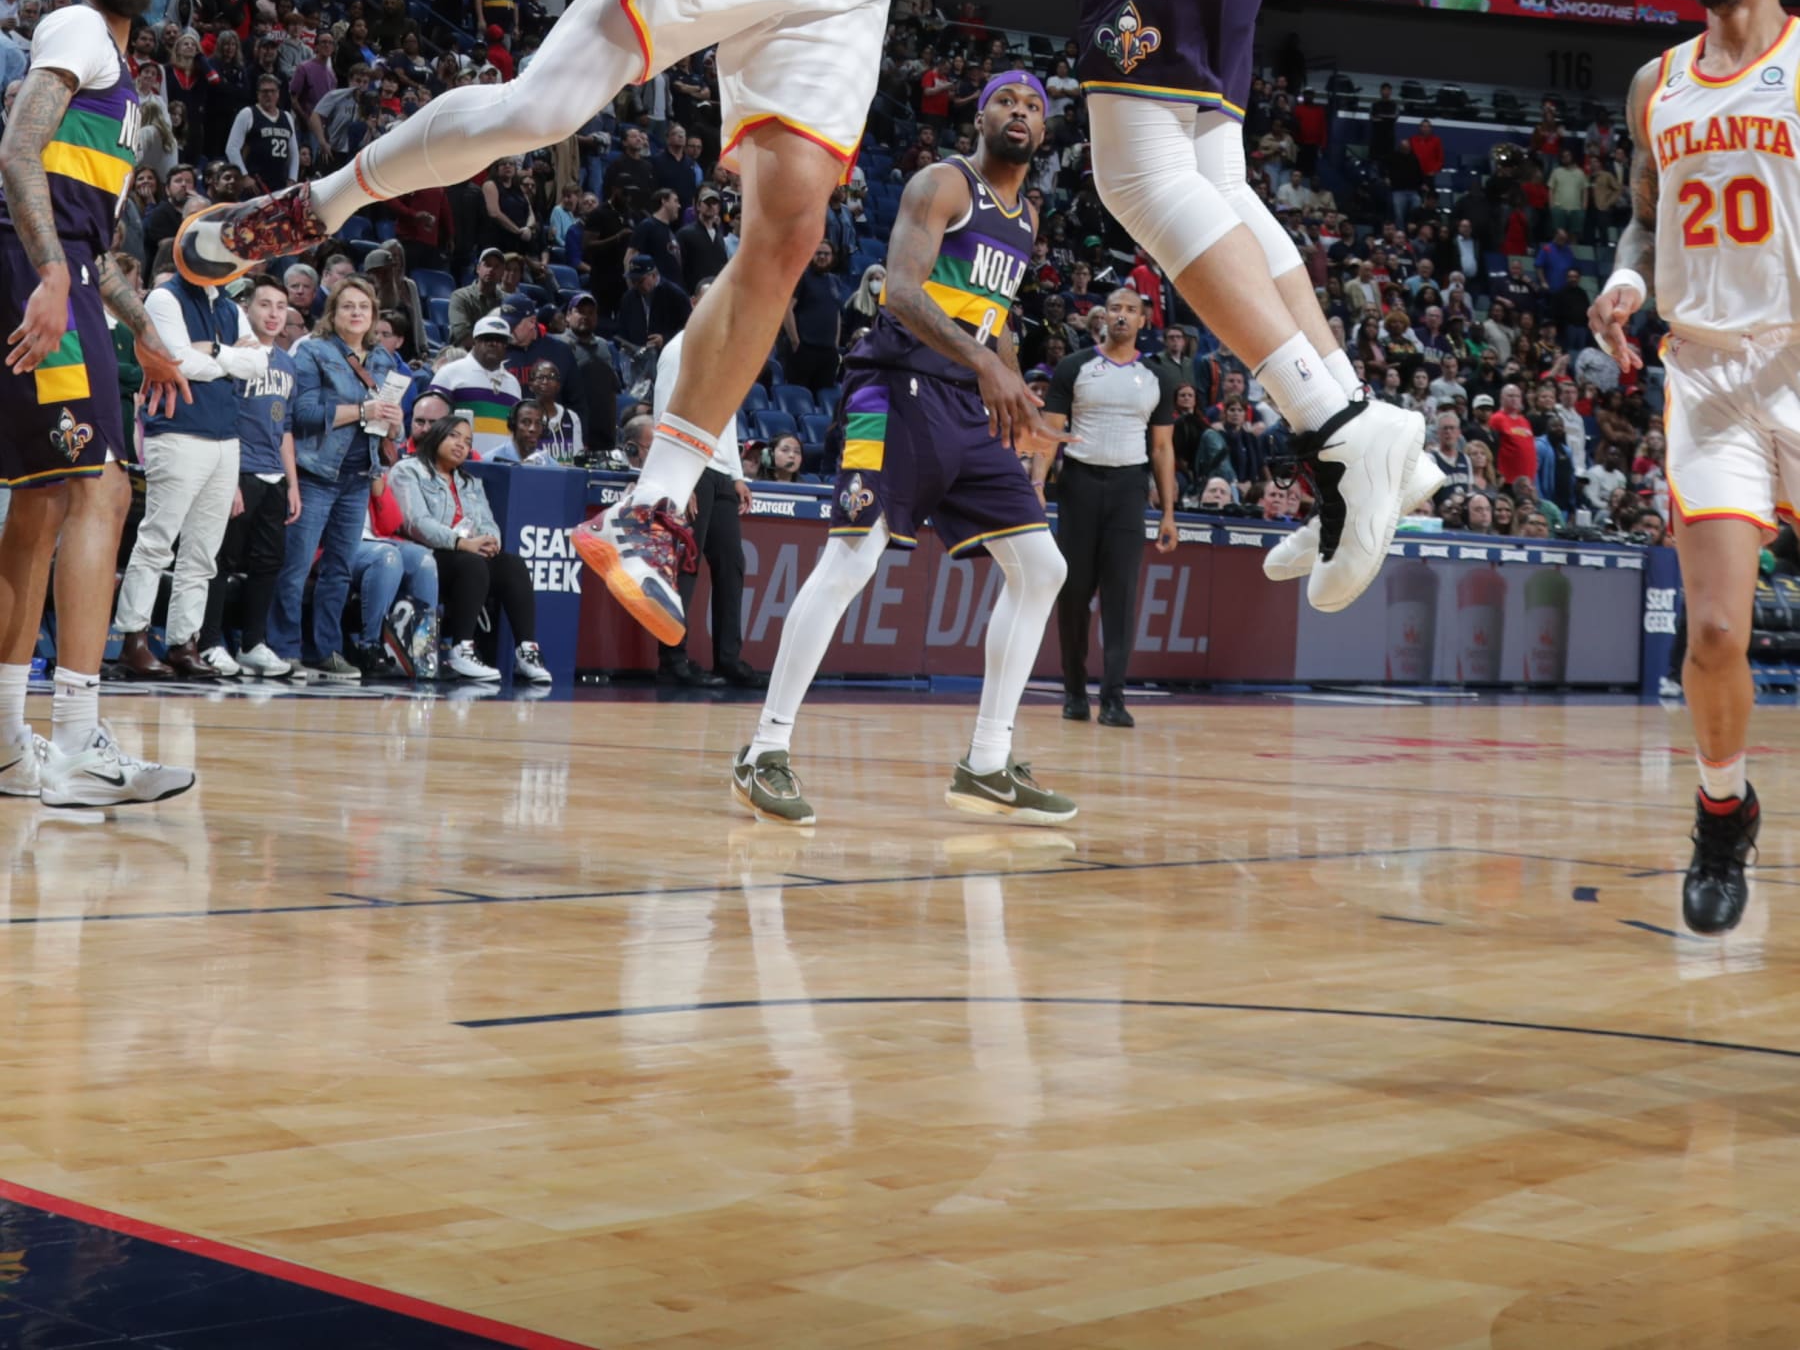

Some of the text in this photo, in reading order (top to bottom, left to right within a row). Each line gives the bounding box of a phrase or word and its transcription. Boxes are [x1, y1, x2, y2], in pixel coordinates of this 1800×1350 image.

[1547, 50, 1593, 91] 116
[271, 138, 288, 158] 22
[1656, 115, 1796, 173] ATLANTA
[1679, 174, 1775, 248] 20
[975, 307, 997, 346] 8
[751, 499, 795, 516] SEATGEEK
[519, 525, 577, 559] SEAT
[1645, 587, 1677, 611] SEAT
